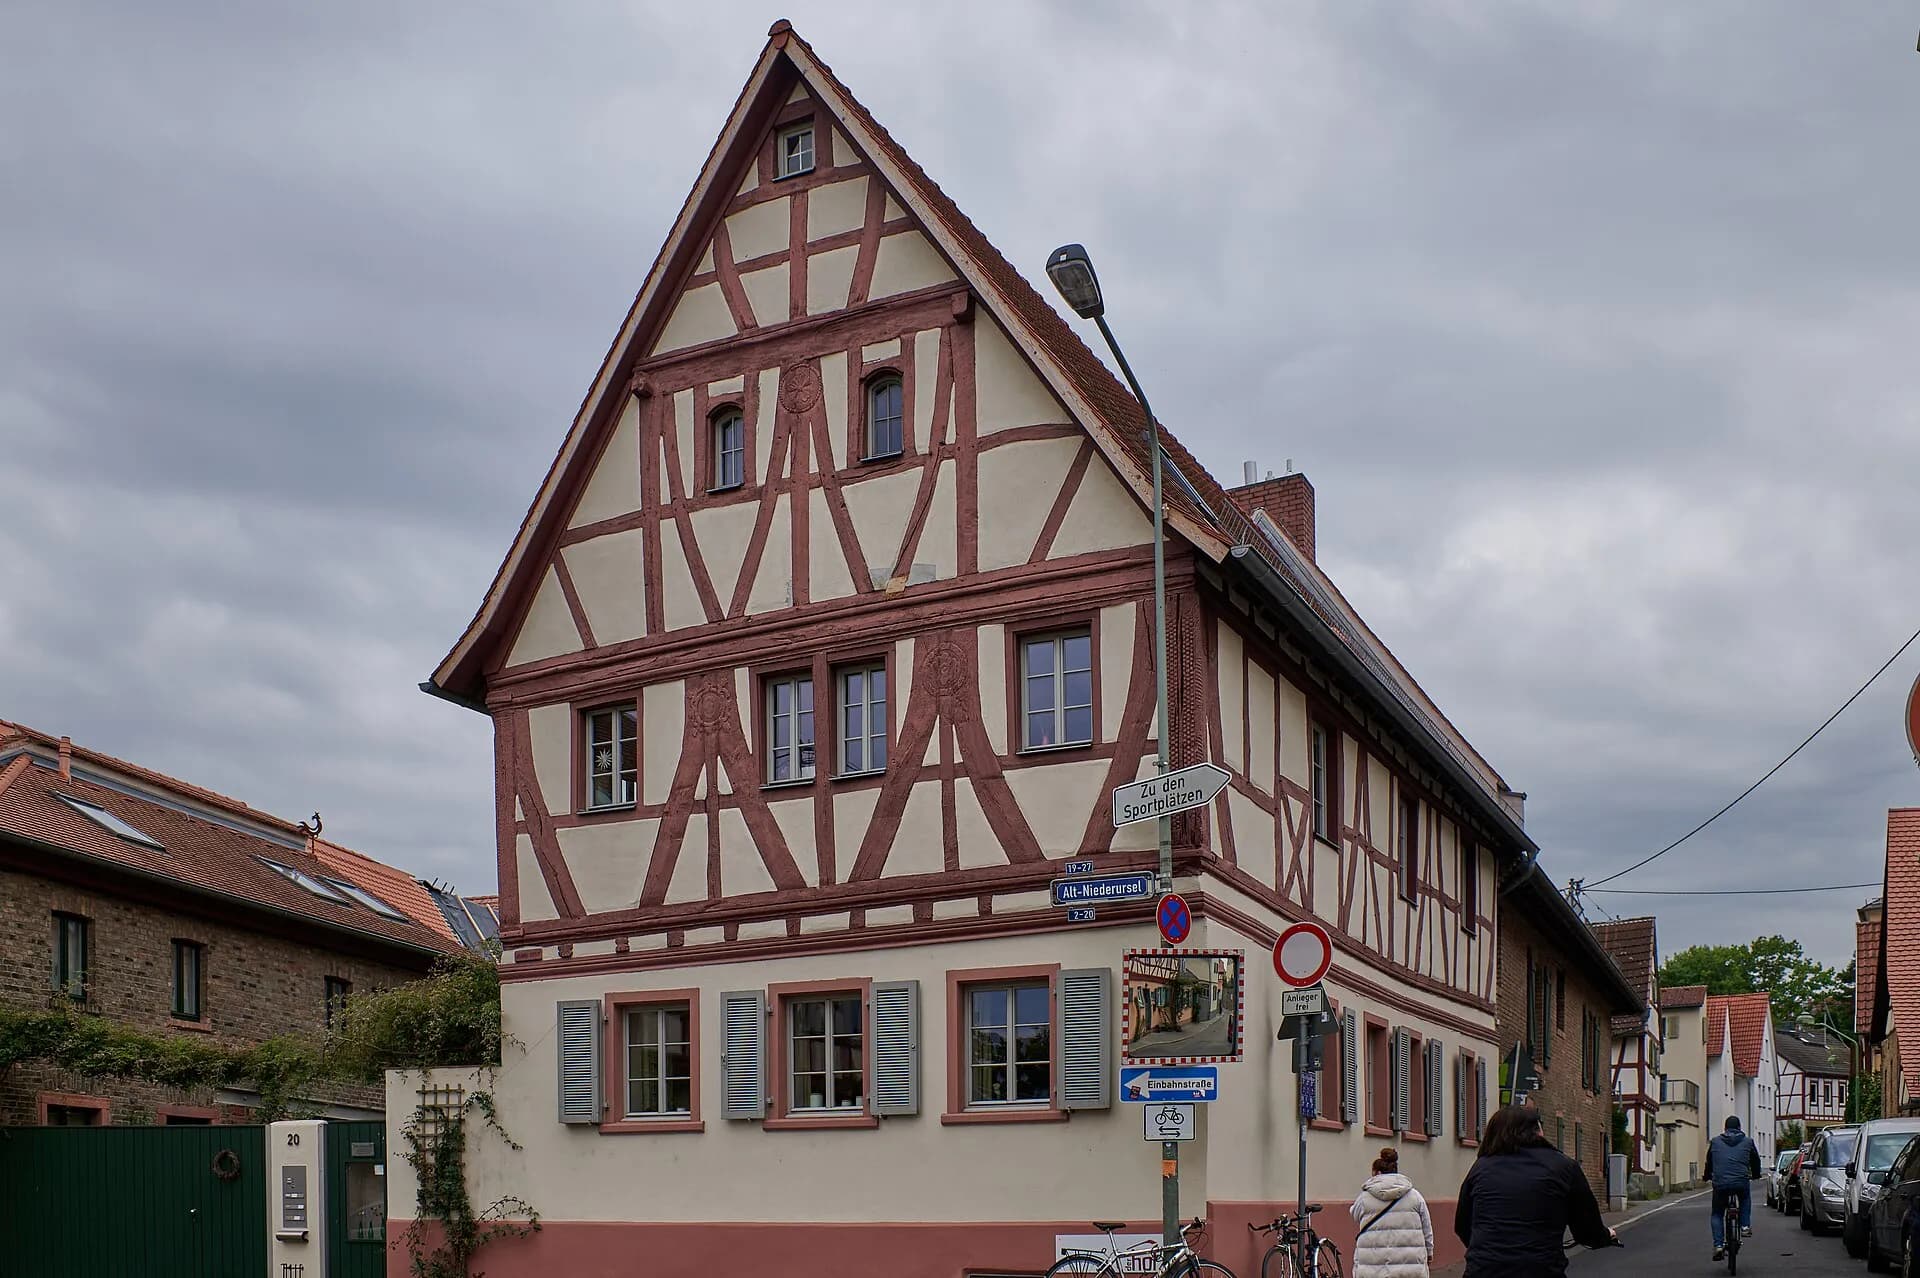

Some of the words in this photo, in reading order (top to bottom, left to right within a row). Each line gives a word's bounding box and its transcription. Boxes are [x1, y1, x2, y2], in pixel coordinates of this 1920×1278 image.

[1141, 784, 1156, 799] Zu
[1162, 777, 1185, 793] den
[1123, 789, 1203, 819] Sportplätzen
[1067, 862, 1092, 873] 19-27
[1062, 879, 1142, 899] Alt-Niederursel
[1074, 910, 1094, 920] 2-20
[1286, 994, 1319, 1002] Anlieger
[1295, 1003, 1309, 1011] frei
[1147, 1079, 1212, 1089] Einbahnstraße
[287, 1133, 300, 1146] 20
